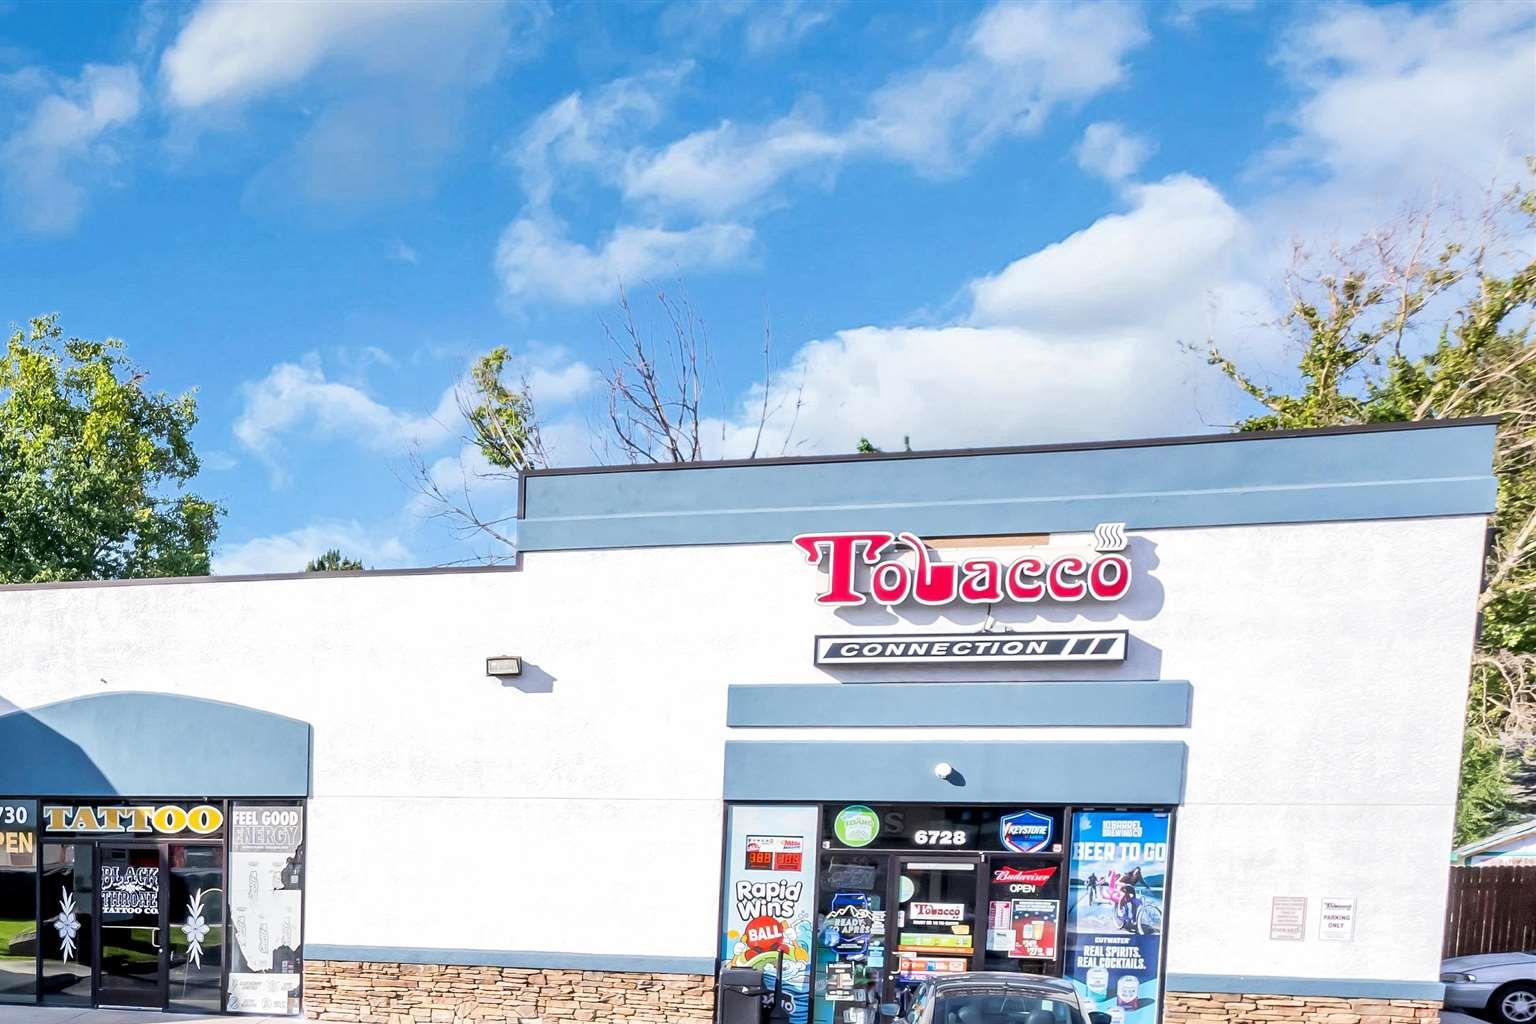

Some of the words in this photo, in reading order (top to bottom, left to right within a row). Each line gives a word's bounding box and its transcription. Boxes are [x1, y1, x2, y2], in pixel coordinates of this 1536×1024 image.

[792, 530, 1132, 606] Tobacco
[840, 640, 1048, 656] CONNECTION
[43, 805, 224, 834] TATTOO
[233, 811, 258, 825] FEEL
[261, 811, 299, 826] GOOD
[914, 829, 967, 845] 6728
[1008, 825, 1048, 835] KEYSTONE
[1073, 842, 1116, 860] BEER
[1119, 842, 1141, 861] TO
[1143, 842, 1166, 861] GO
[102, 865, 159, 892] BLACK
[994, 869, 1050, 882] Budweiser
[736, 879, 803, 903] Rapid
[1009, 884, 1036, 893] OPEN
[101, 891, 158, 907] THRONE
[736, 898, 796, 921] Wins
[748, 924, 783, 942] BALL
[1083, 946, 1105, 957] REAL
[1105, 946, 1142, 958] SPIRITS.
[1077, 956, 1098, 968] REAL
[1099, 957, 1147, 970] COCKTAILS.
